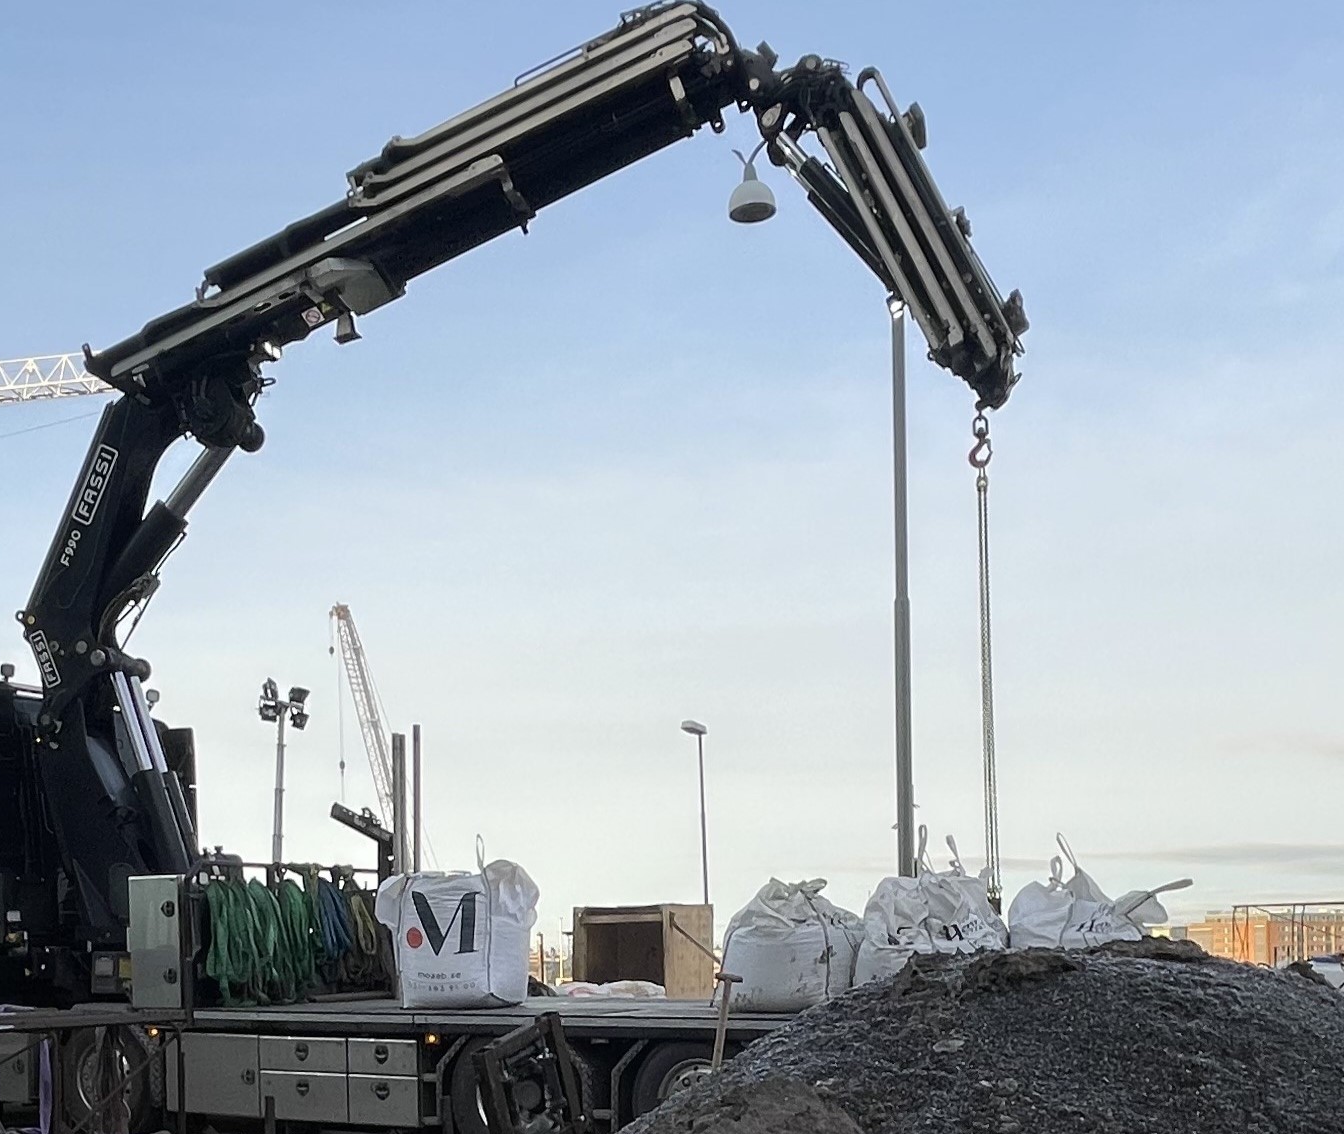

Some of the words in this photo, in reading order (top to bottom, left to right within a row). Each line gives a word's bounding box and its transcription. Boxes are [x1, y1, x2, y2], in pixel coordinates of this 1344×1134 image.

[77, 451, 114, 518] FASSI
[60, 529, 81, 567] F990
[33, 634, 57, 683] FASSI
[412, 891, 481, 956] M
